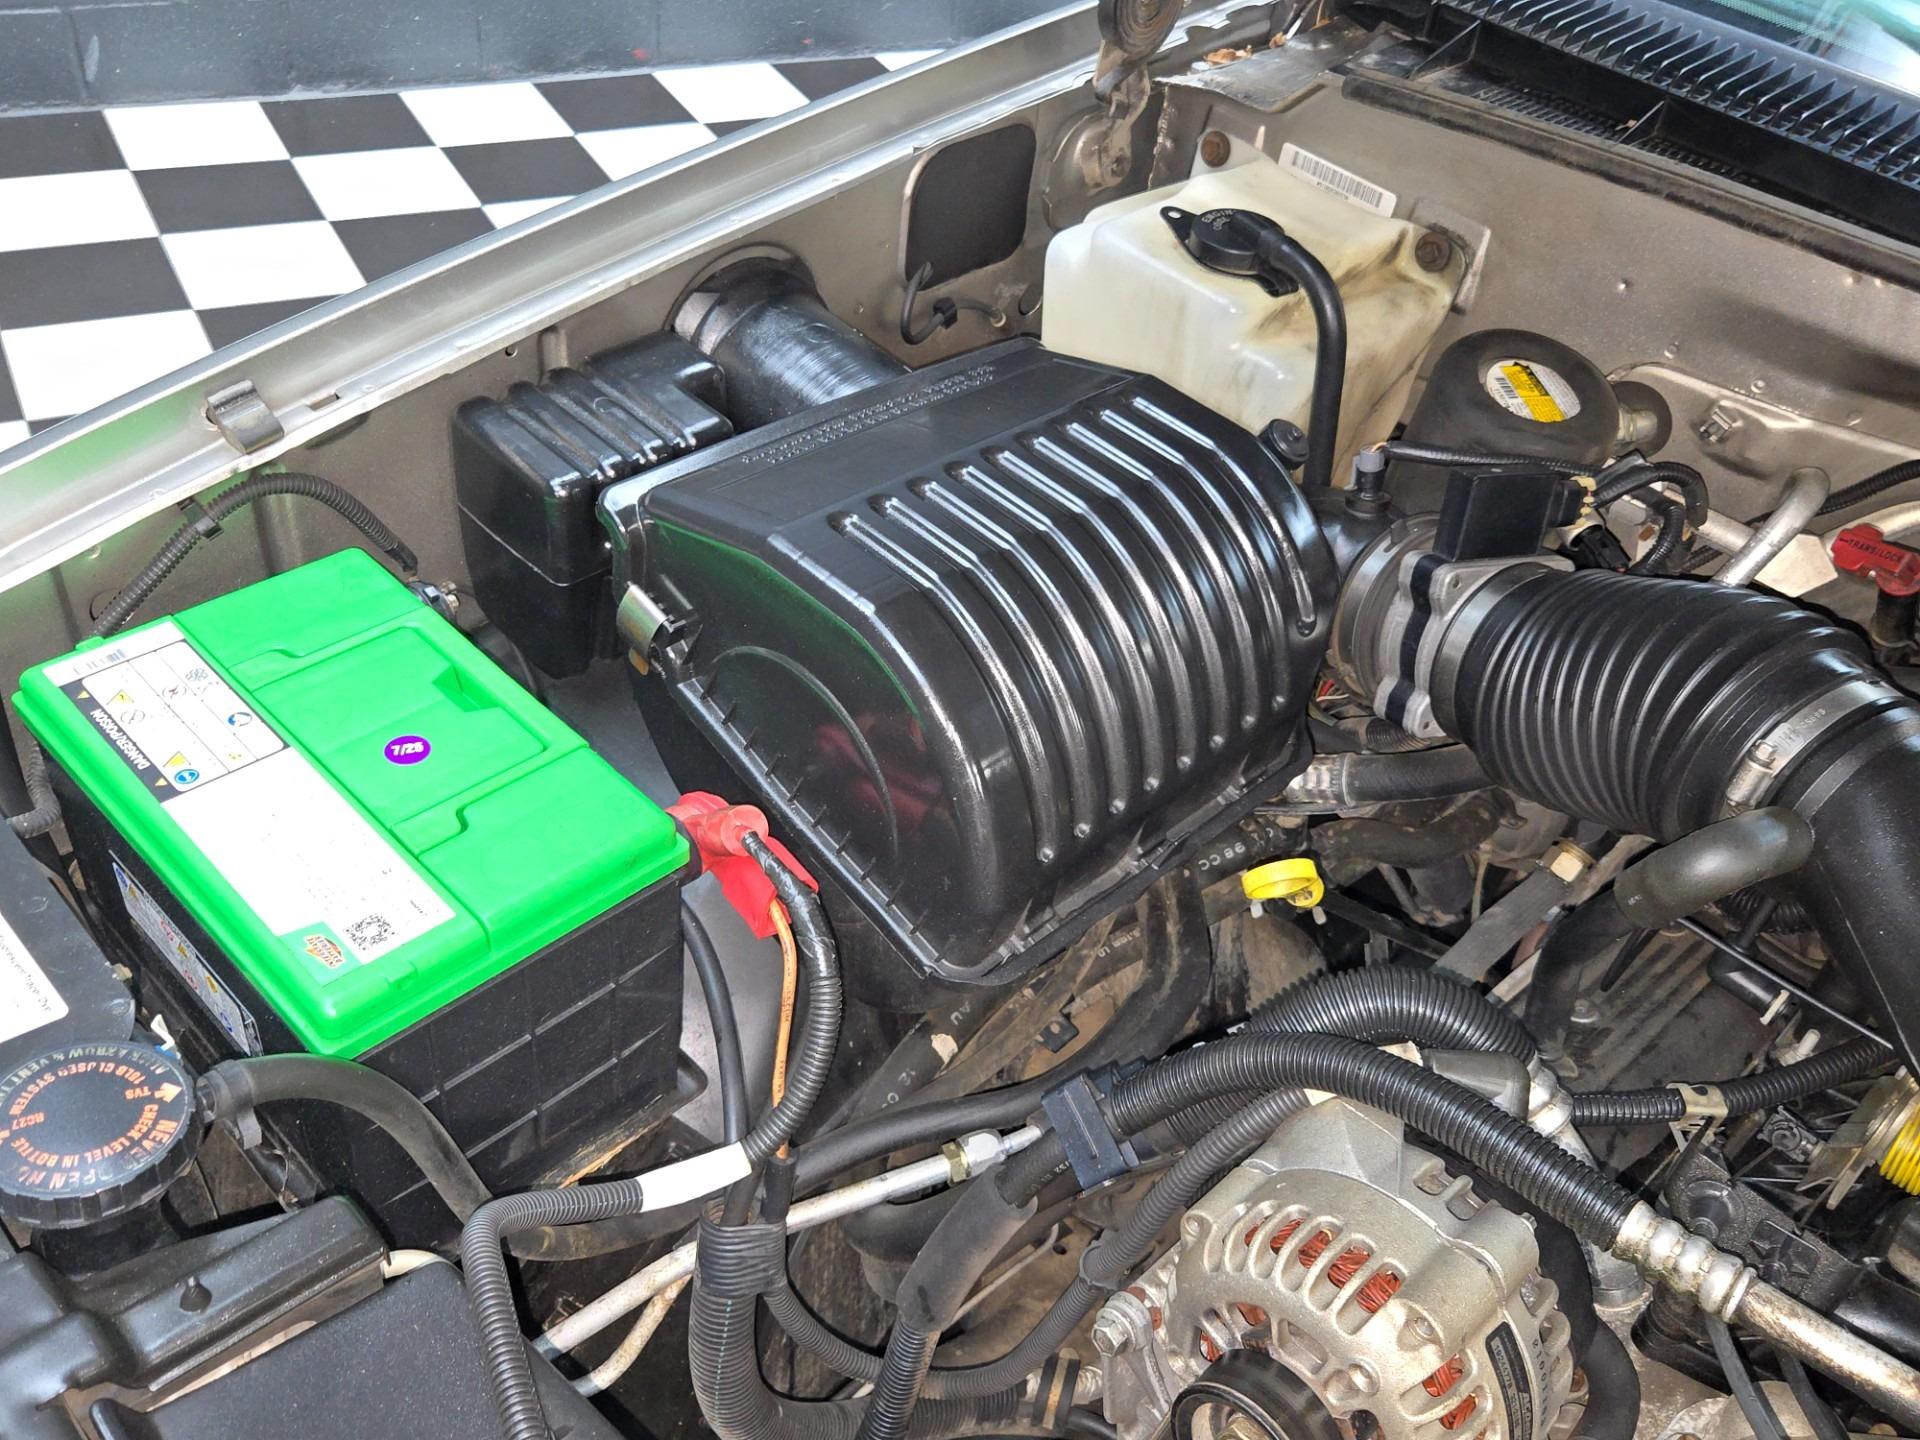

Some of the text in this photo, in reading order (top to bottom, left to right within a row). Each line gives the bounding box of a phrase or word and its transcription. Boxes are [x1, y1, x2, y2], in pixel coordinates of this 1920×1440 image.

[1201, 208, 1236, 224] ENGIN
[390, 741, 425, 757] 7/26
[10, 1057, 50, 1086] VENT
[8, 1071, 56, 1117] SYSTEM
[124, 1085, 153, 1101] TVS
[11, 1111, 46, 1131] RC27
[10, 1103, 160, 1169] CHECK LEVEL IN BOTTLE
